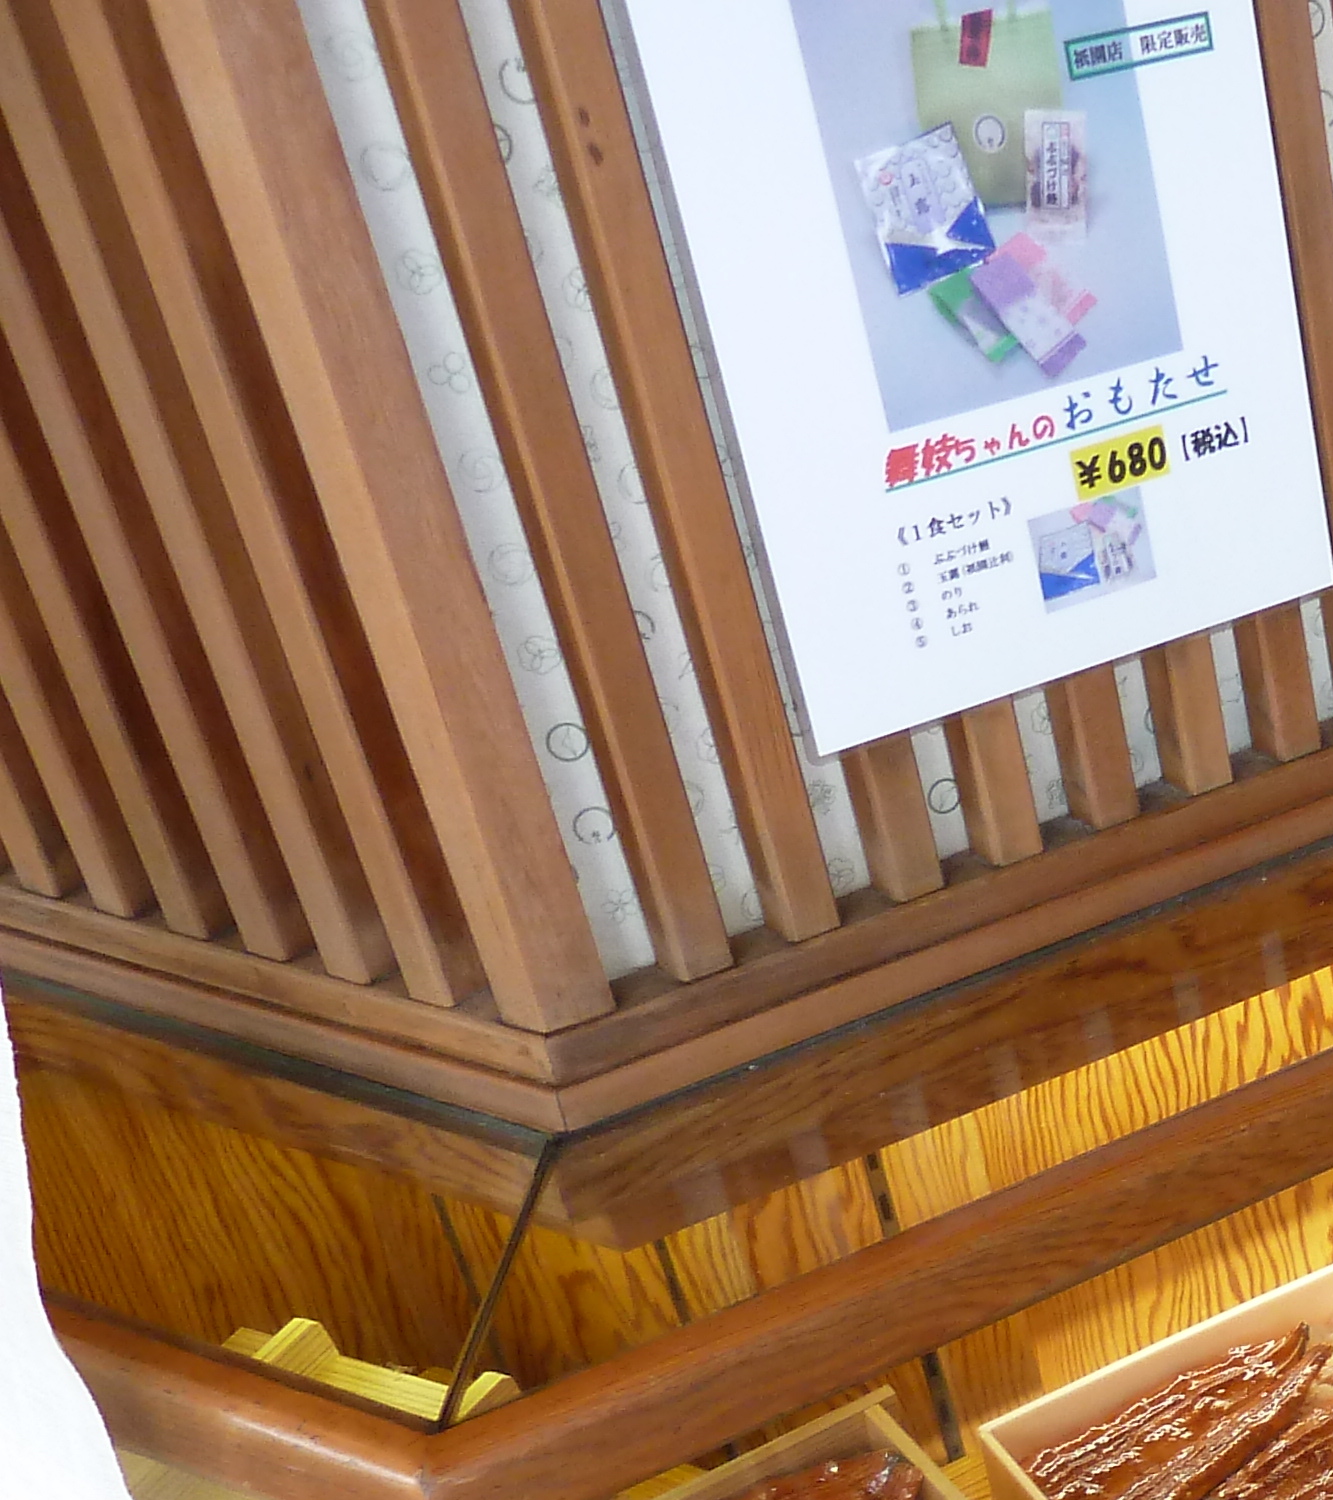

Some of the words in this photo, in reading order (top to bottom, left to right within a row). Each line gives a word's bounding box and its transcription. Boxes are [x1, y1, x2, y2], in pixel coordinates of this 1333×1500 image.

[1140, 24, 1207, 53] 限定販売
[1075, 437, 1166, 489] ¥680
